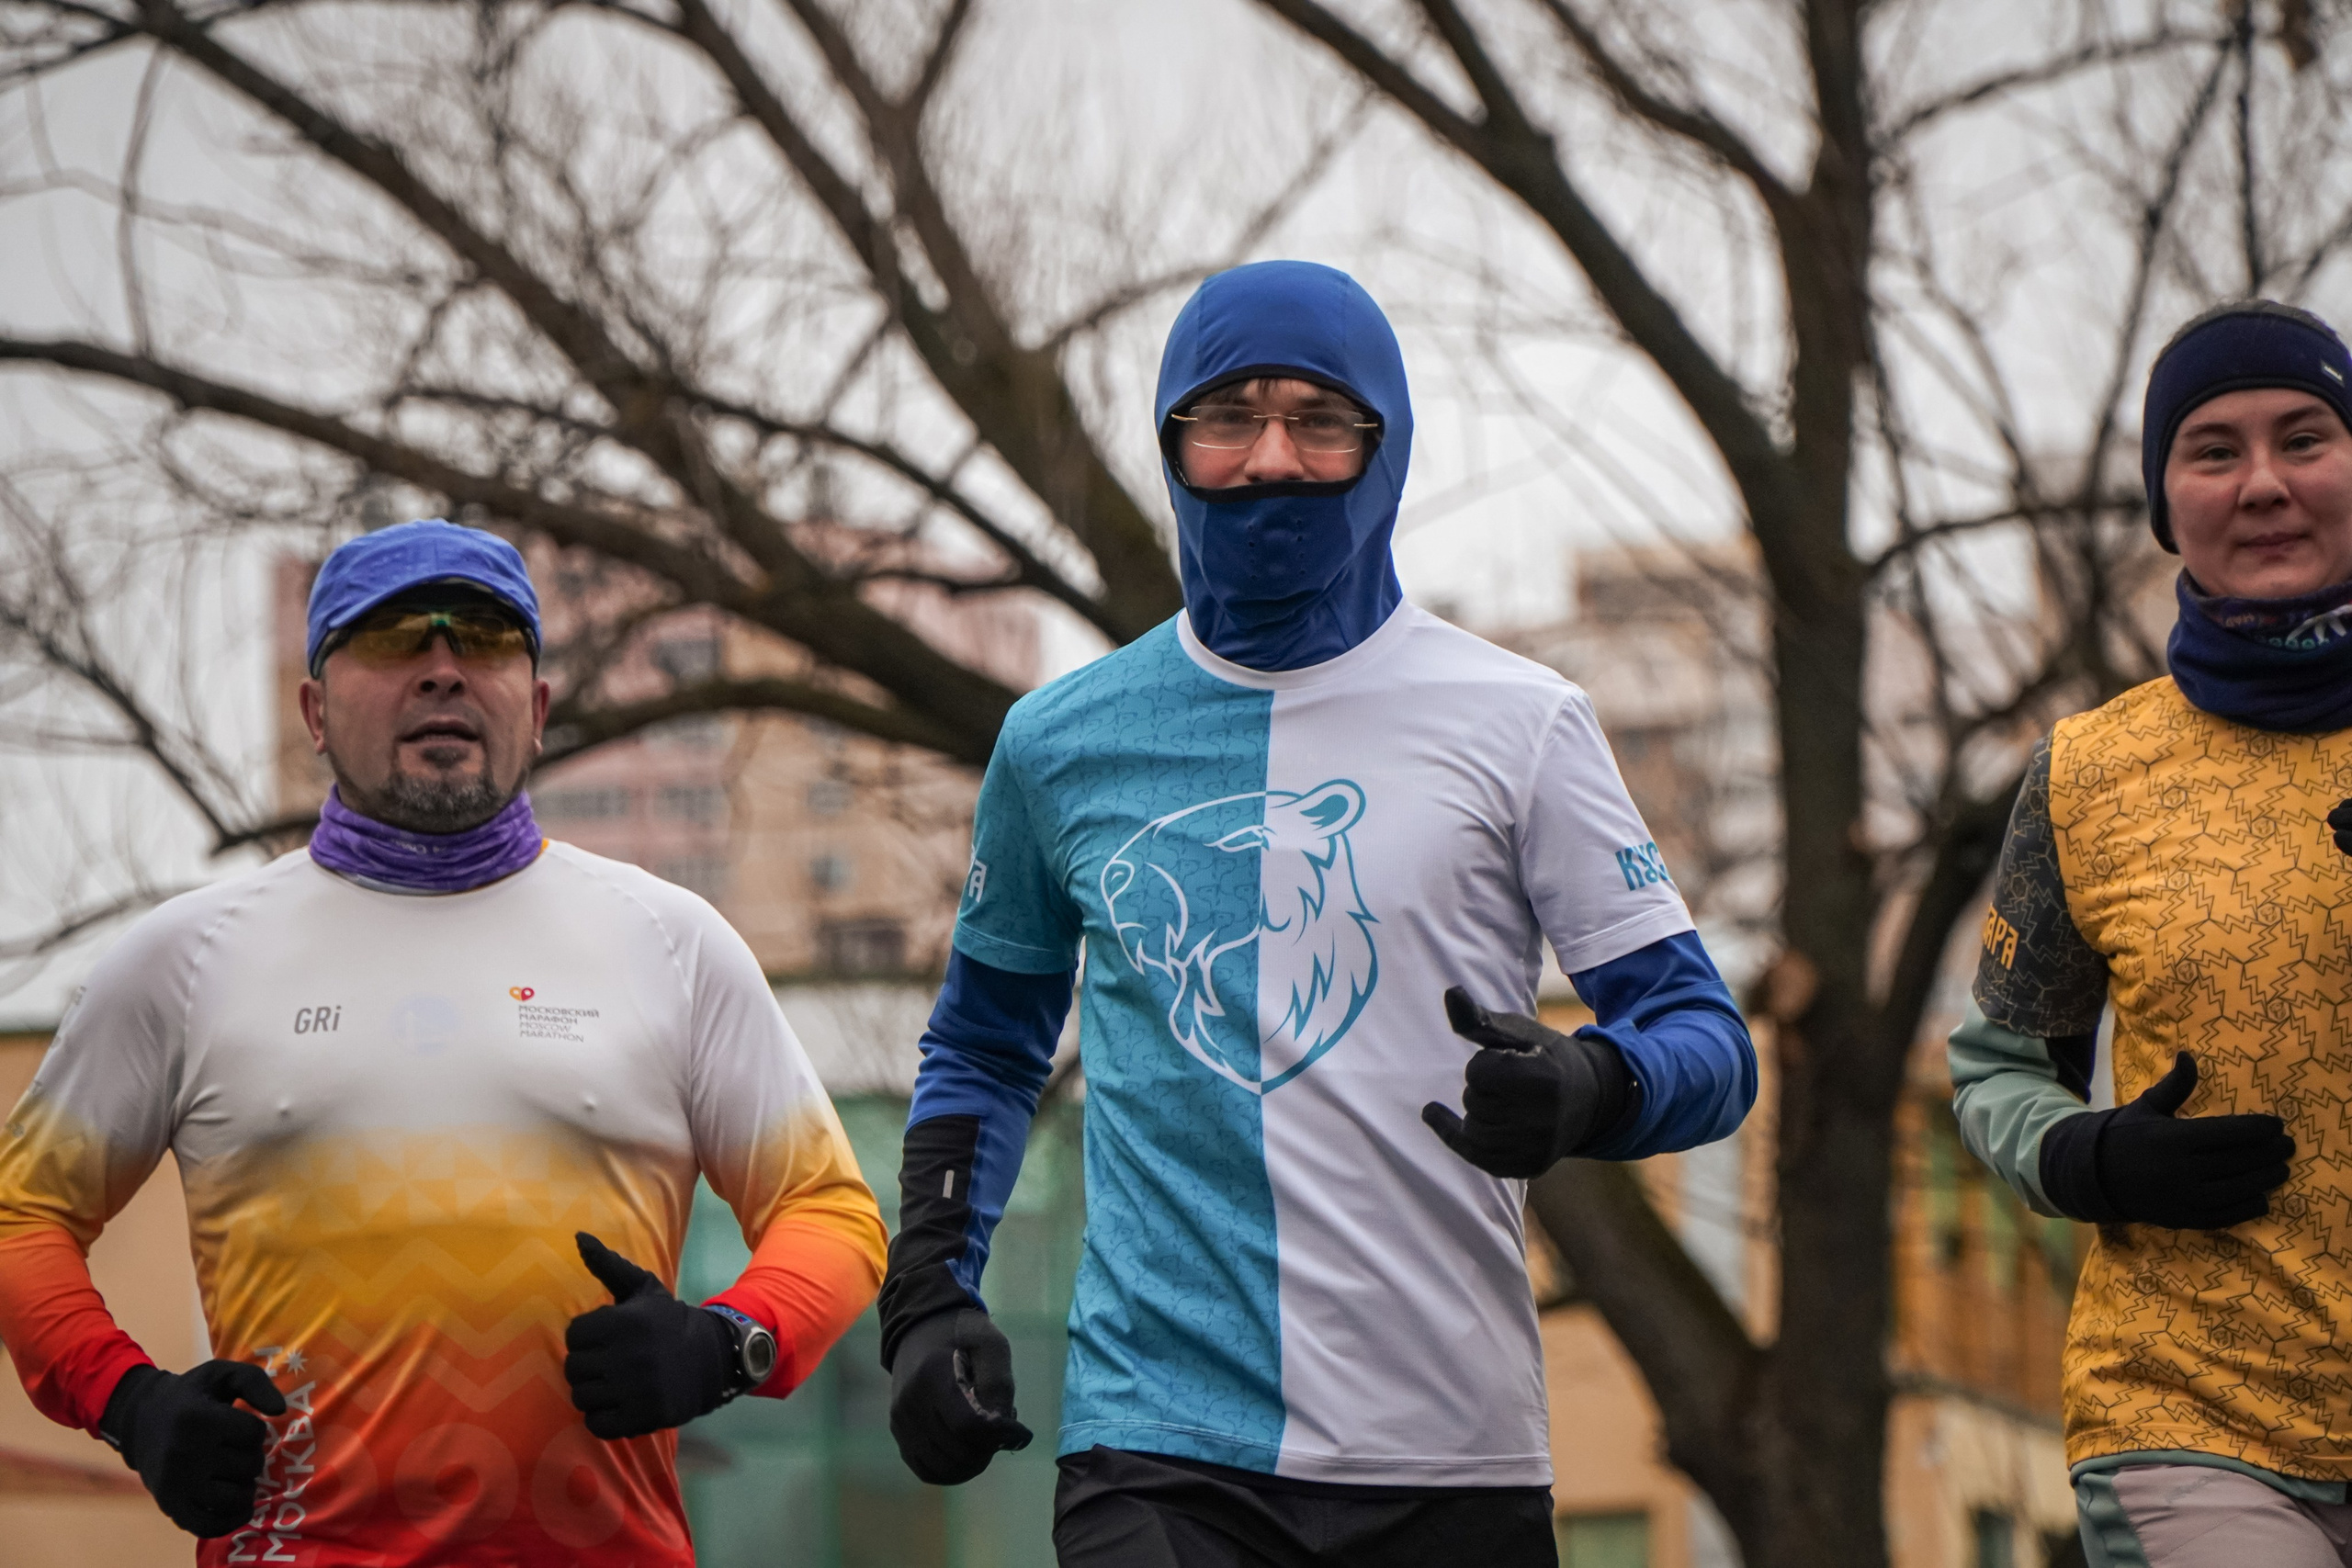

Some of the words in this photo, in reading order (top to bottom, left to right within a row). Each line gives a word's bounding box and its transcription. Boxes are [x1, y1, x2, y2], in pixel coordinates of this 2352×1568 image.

[518, 1005, 600, 1018] МОСКОВСКИЙ
[519, 1013, 578, 1025] МАРАФОН
[519, 1021, 571, 1033] MOSCOW
[520, 1030, 584, 1043] MARATHON
[262, 1381, 316, 1562] МОСКВА
